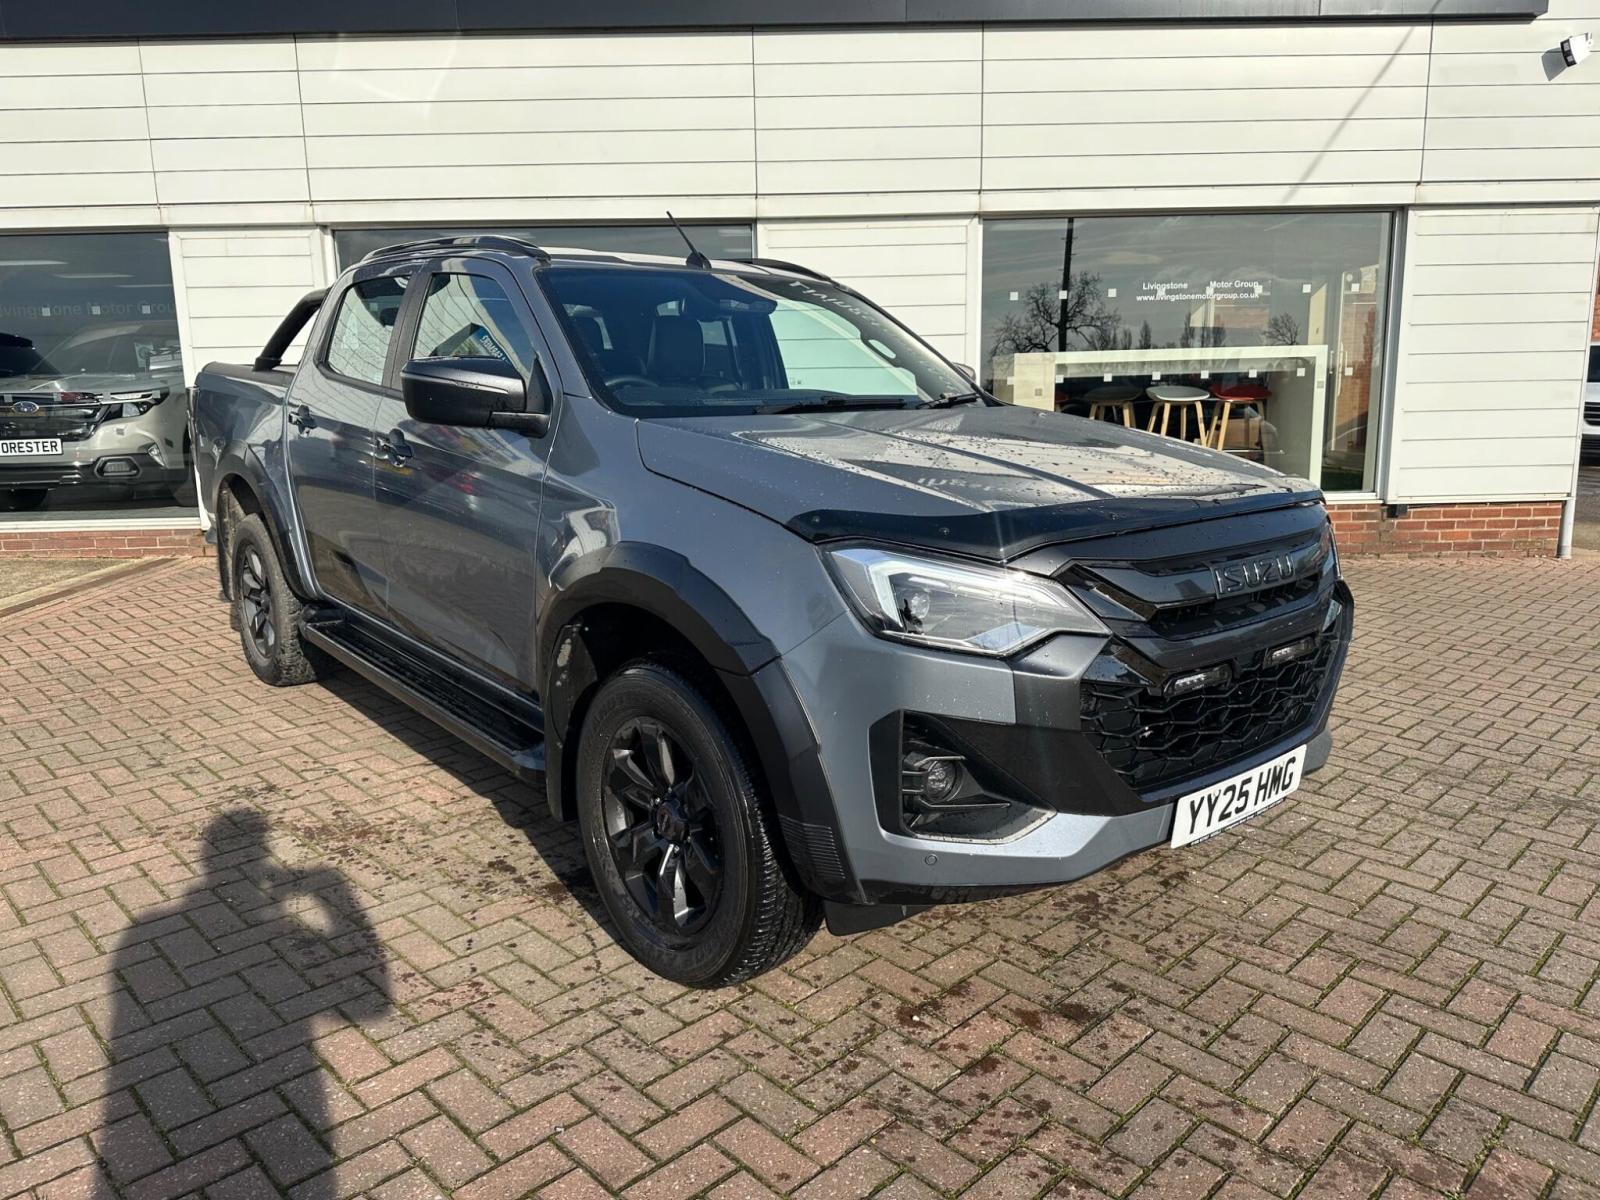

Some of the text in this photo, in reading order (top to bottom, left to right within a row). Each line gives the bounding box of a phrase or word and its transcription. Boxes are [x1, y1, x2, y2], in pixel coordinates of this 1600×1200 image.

[1142, 280, 1259, 291] Livingstone Motor Group
[1215, 555, 1294, 594] ISUZU
[1189, 776, 1253, 834] YY25
[1253, 756, 1296, 806] HMG
